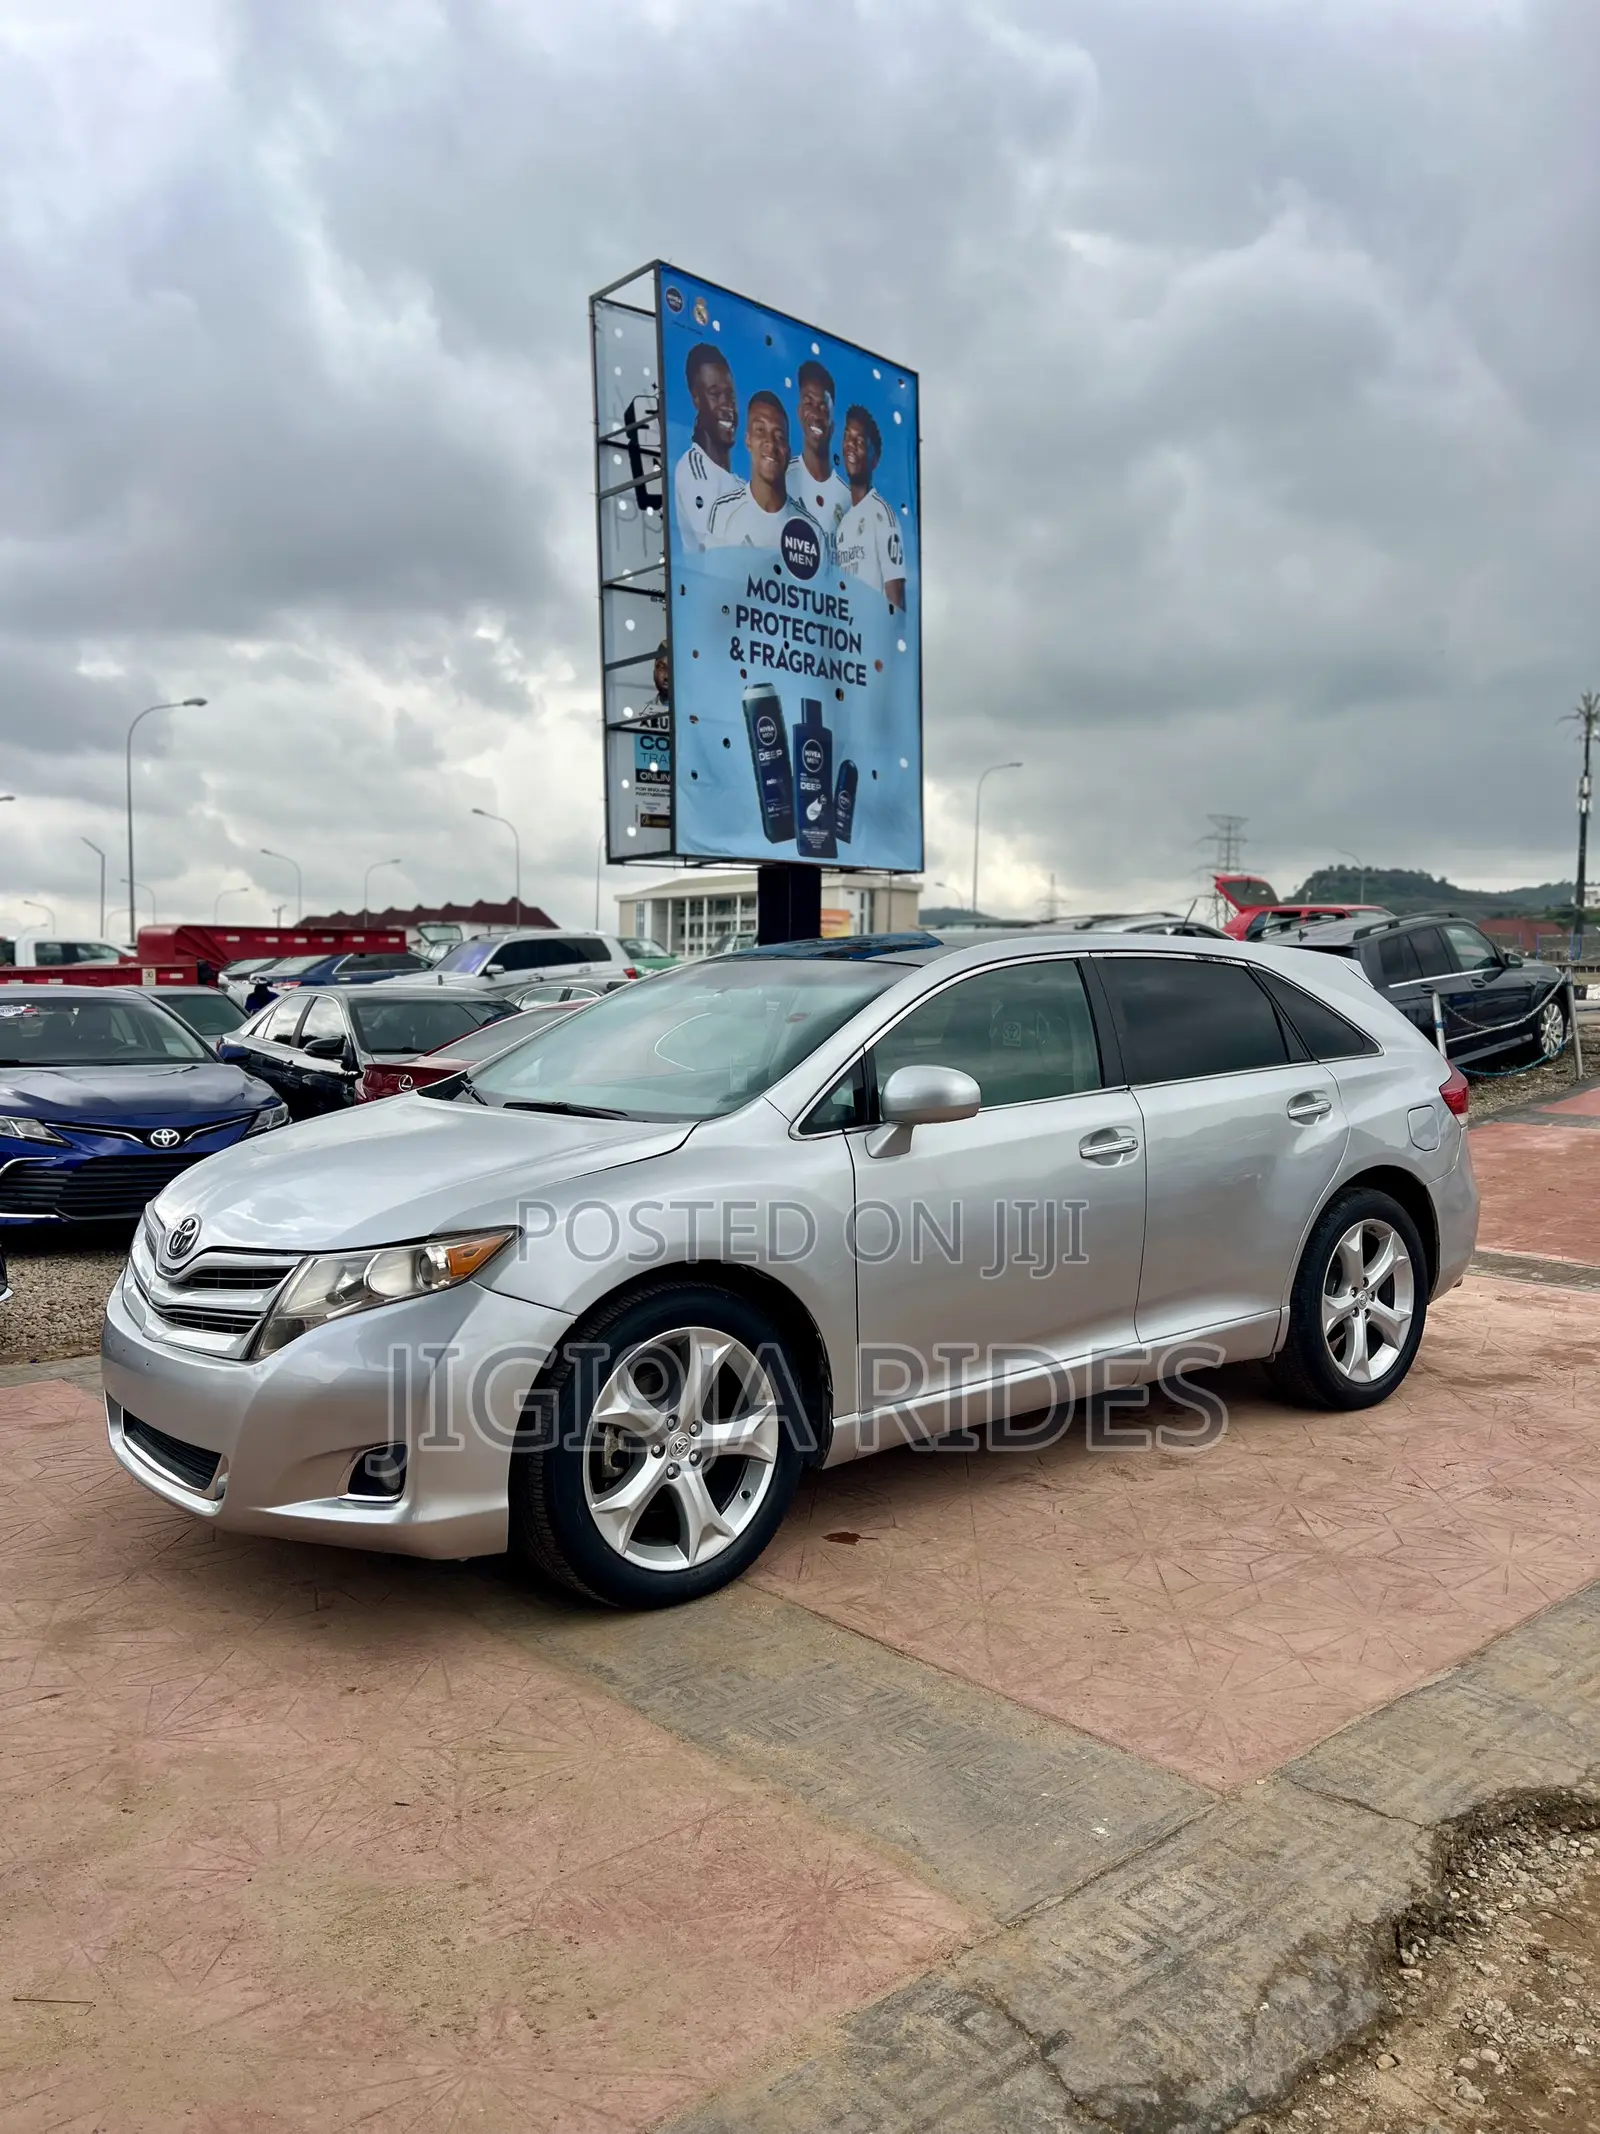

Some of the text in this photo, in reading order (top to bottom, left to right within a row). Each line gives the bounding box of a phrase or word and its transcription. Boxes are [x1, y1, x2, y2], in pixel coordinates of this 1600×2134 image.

[784, 535, 818, 556] NIVEA
[788, 551, 813, 568] MEN
[746, 573, 854, 627] MOISTURE,
[736, 604, 862, 655] PROTECTION
[729, 636, 867, 687] & FRAGRANCE
[759, 749, 783, 761] DEEP
[800, 782, 821, 791] DEEP
